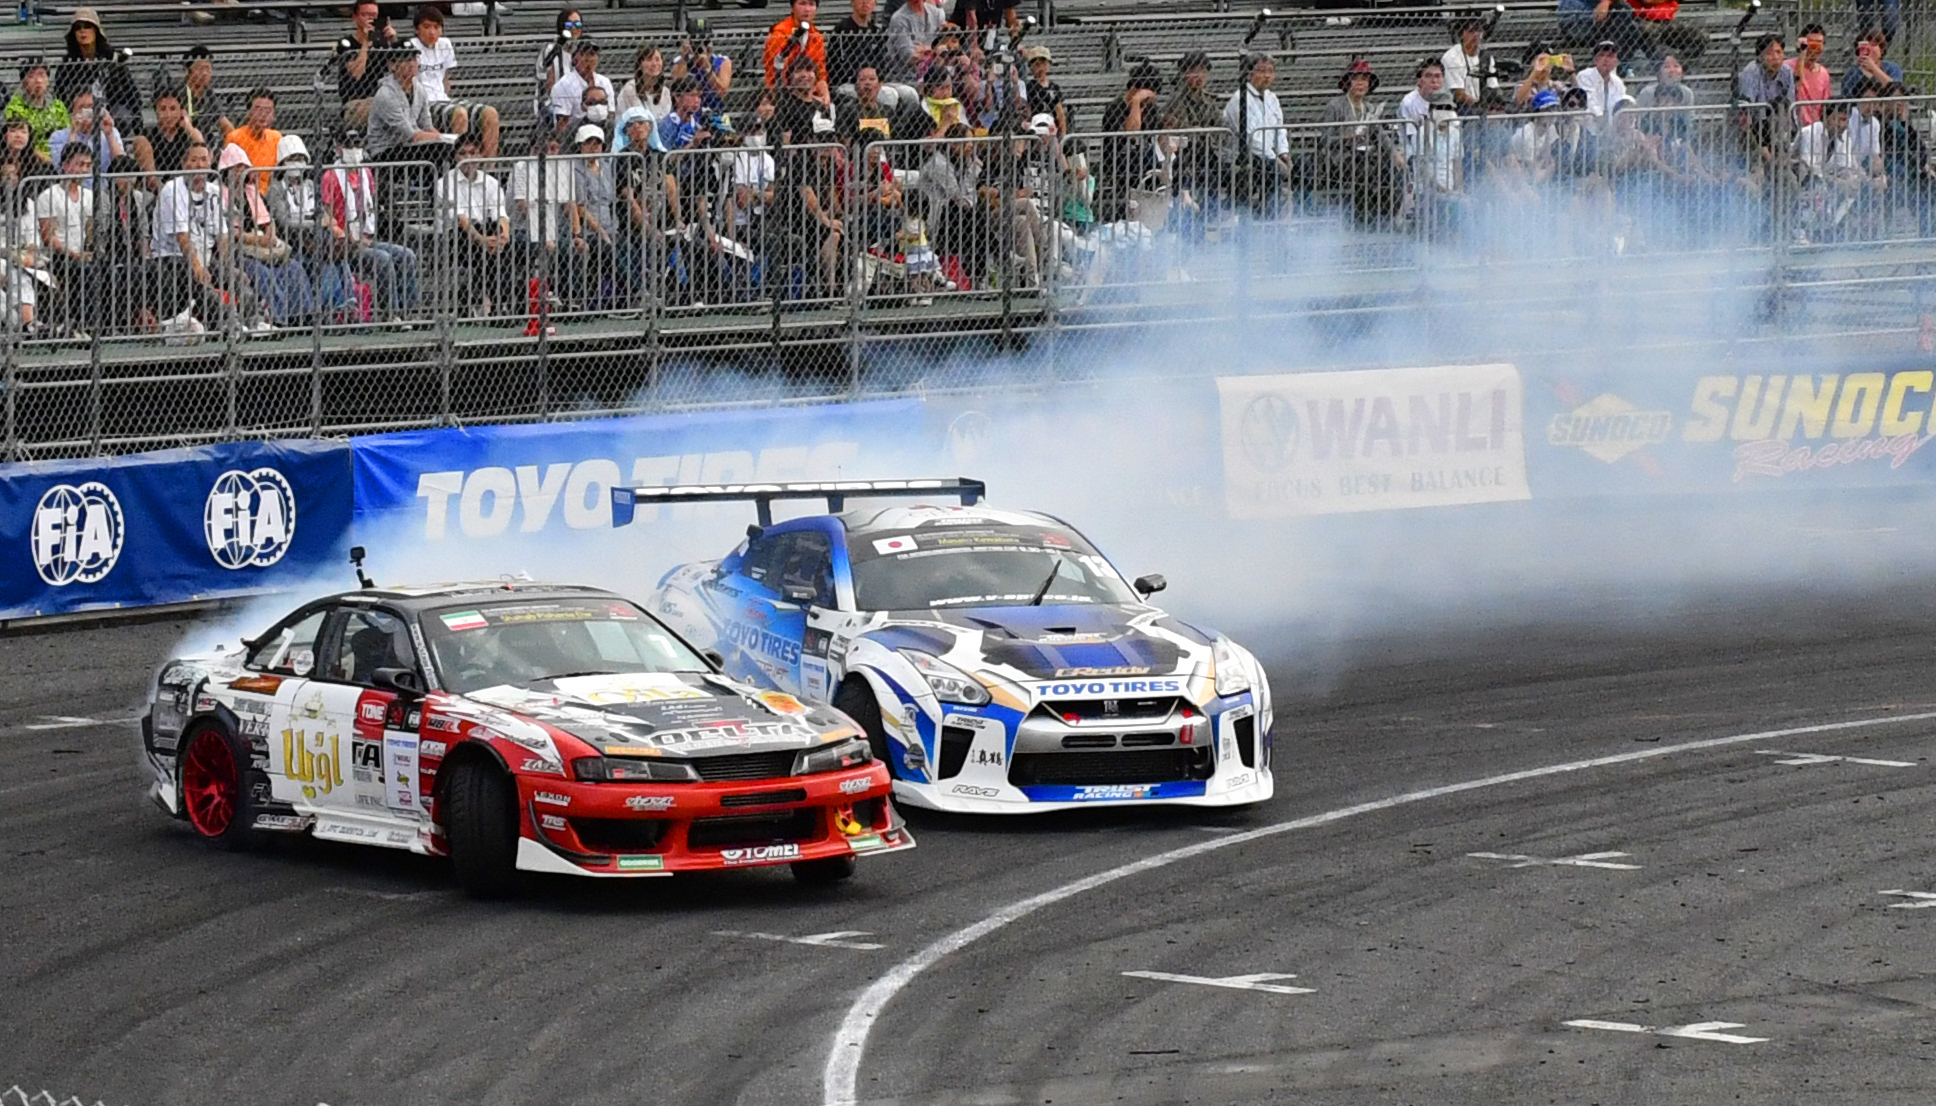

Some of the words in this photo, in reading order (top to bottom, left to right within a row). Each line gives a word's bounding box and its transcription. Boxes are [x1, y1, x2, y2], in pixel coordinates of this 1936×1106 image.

[1682, 371, 1936, 442] SUNOC
[1306, 389, 1506, 461] WANLI
[1550, 413, 1670, 443] SUNOCO
[1732, 434, 1934, 483] Racing
[417, 459, 621, 540] TOYO
[1079, 555, 1120, 580] 13
[760, 632, 802, 667] TIRES
[1036, 682, 1105, 697] TOYO
[1107, 680, 1180, 696] TIRES
[743, 844, 800, 859] TOMEI
